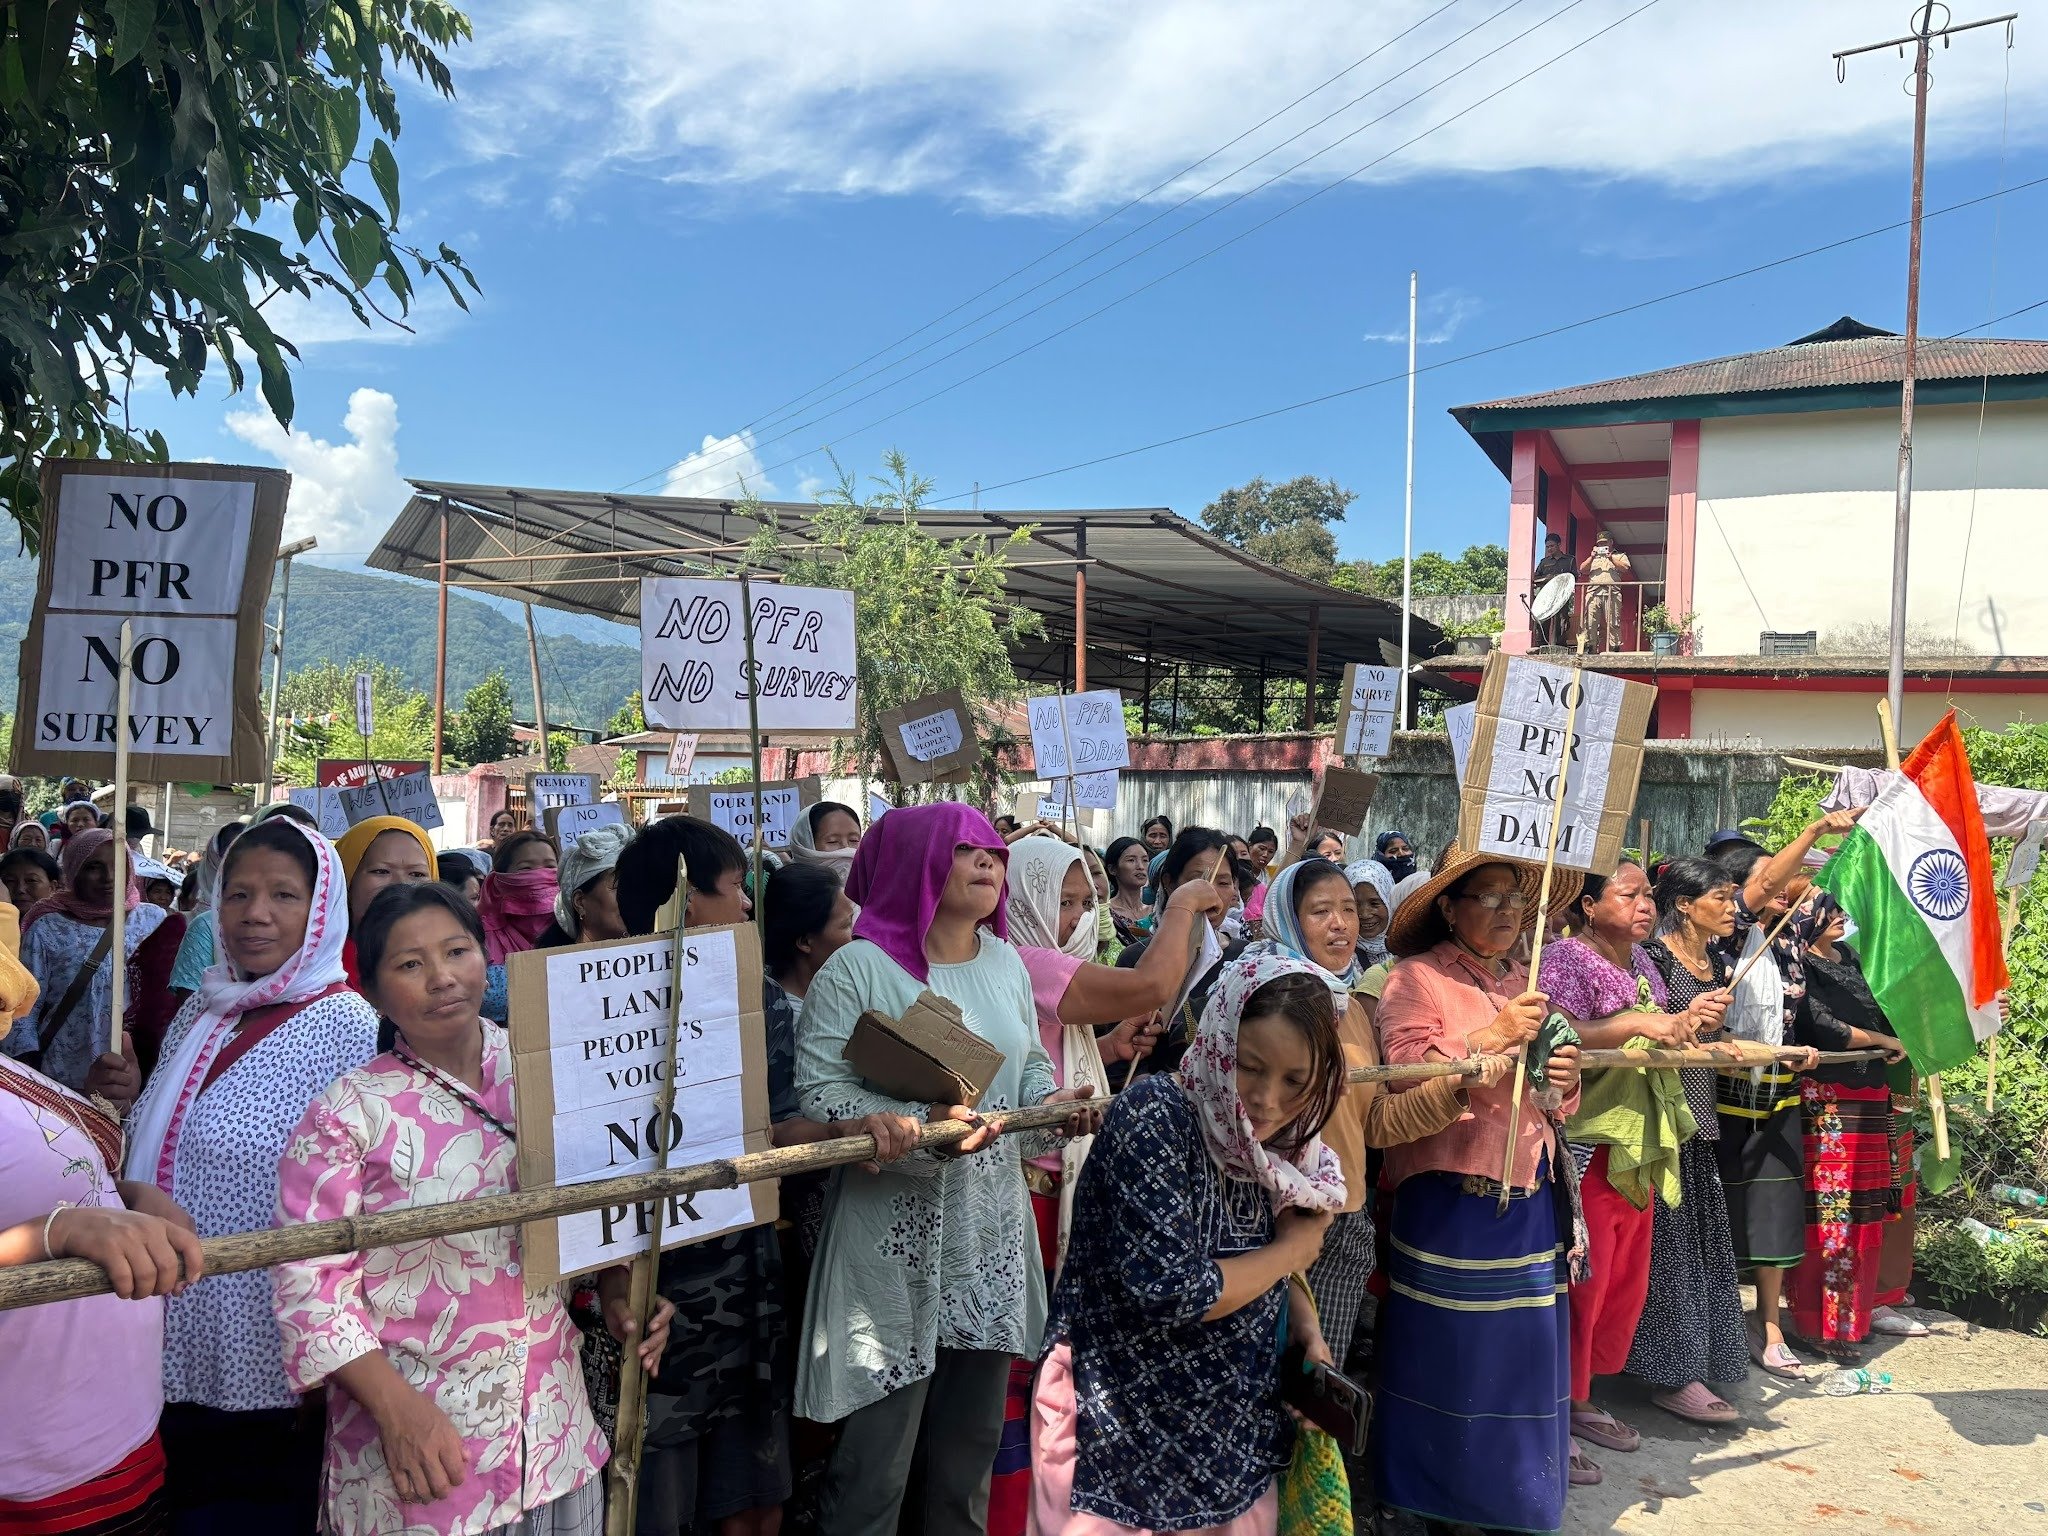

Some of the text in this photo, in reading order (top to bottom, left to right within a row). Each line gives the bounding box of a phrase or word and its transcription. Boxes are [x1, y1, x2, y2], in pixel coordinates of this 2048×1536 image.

[103, 492, 188, 533] NO
[87, 558, 193, 600] PFR
[654, 595, 824, 653] NO PFR
[77, 635, 180, 686] NO
[1367, 670, 1385, 682] NO
[648, 659, 857, 704] NO SURVEY
[1353, 688, 1393, 703] SURVE
[1534, 674, 1586, 711] NO
[40, 711, 213, 746] SURVEY
[908, 714, 945, 731] PEOPLE'S
[1034, 701, 1113, 731] NO PFR
[914, 734, 952, 751] PEOPLE'S
[917, 726, 943, 740] LAND
[1517, 723, 1582, 763] PFR
[923, 745, 949, 758] VOICE
[1041, 737, 1126, 768] NO DAM
[535, 778, 588, 787] REMOVE
[1519, 768, 1569, 802] NO
[542, 793, 580, 807] THE
[576, 809, 598, 821] NO
[713, 797, 747, 809] OUR
[1494, 813, 1576, 854] DAM
[605, 1057, 687, 1091] VOICE
[604, 1111, 684, 1167] NO
